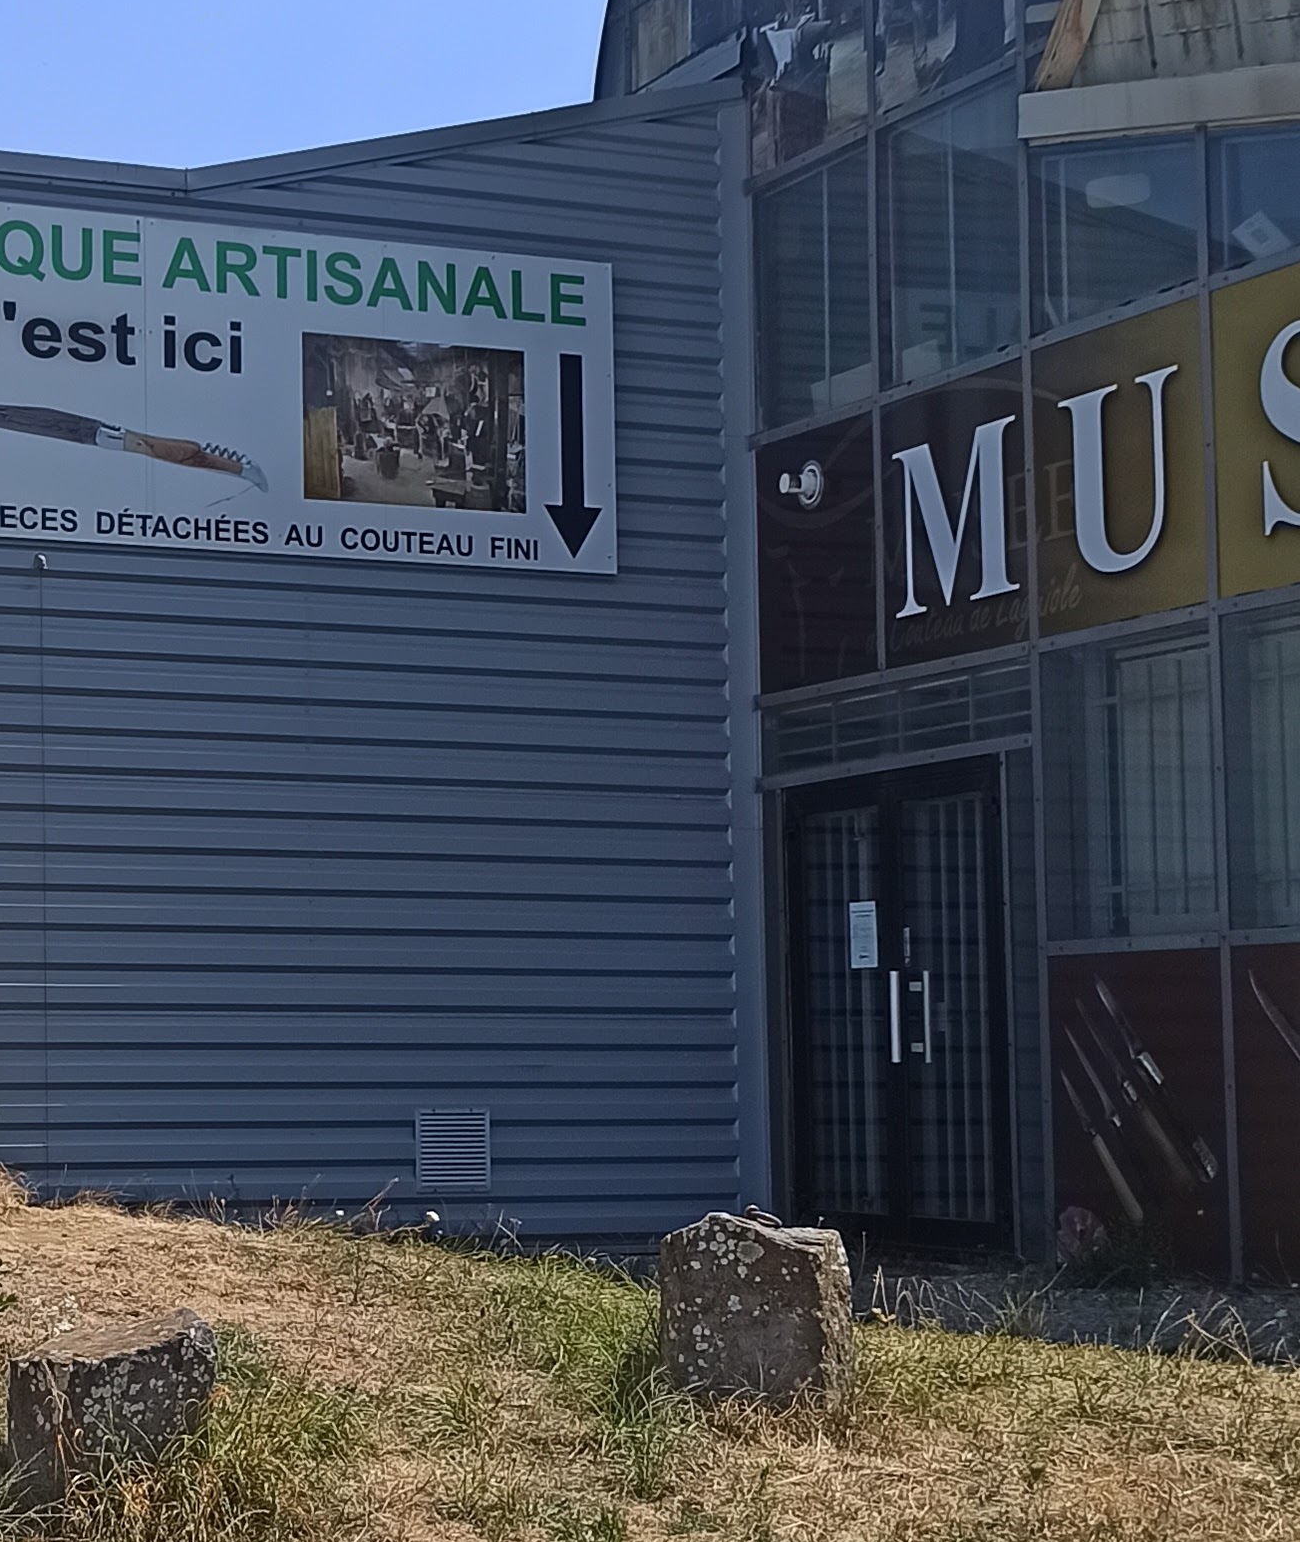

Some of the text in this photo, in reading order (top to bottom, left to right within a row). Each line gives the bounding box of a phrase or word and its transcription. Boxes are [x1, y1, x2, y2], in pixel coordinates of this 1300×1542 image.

[161, 237, 587, 327] ARTISANALE
[163, 315, 243, 374] ici
[96, 508, 269, 544] DÉTACHÉES
[284, 524, 323, 548] AU
[340, 527, 474, 557] COUTEAU
[490, 536, 539, 561] FINI
